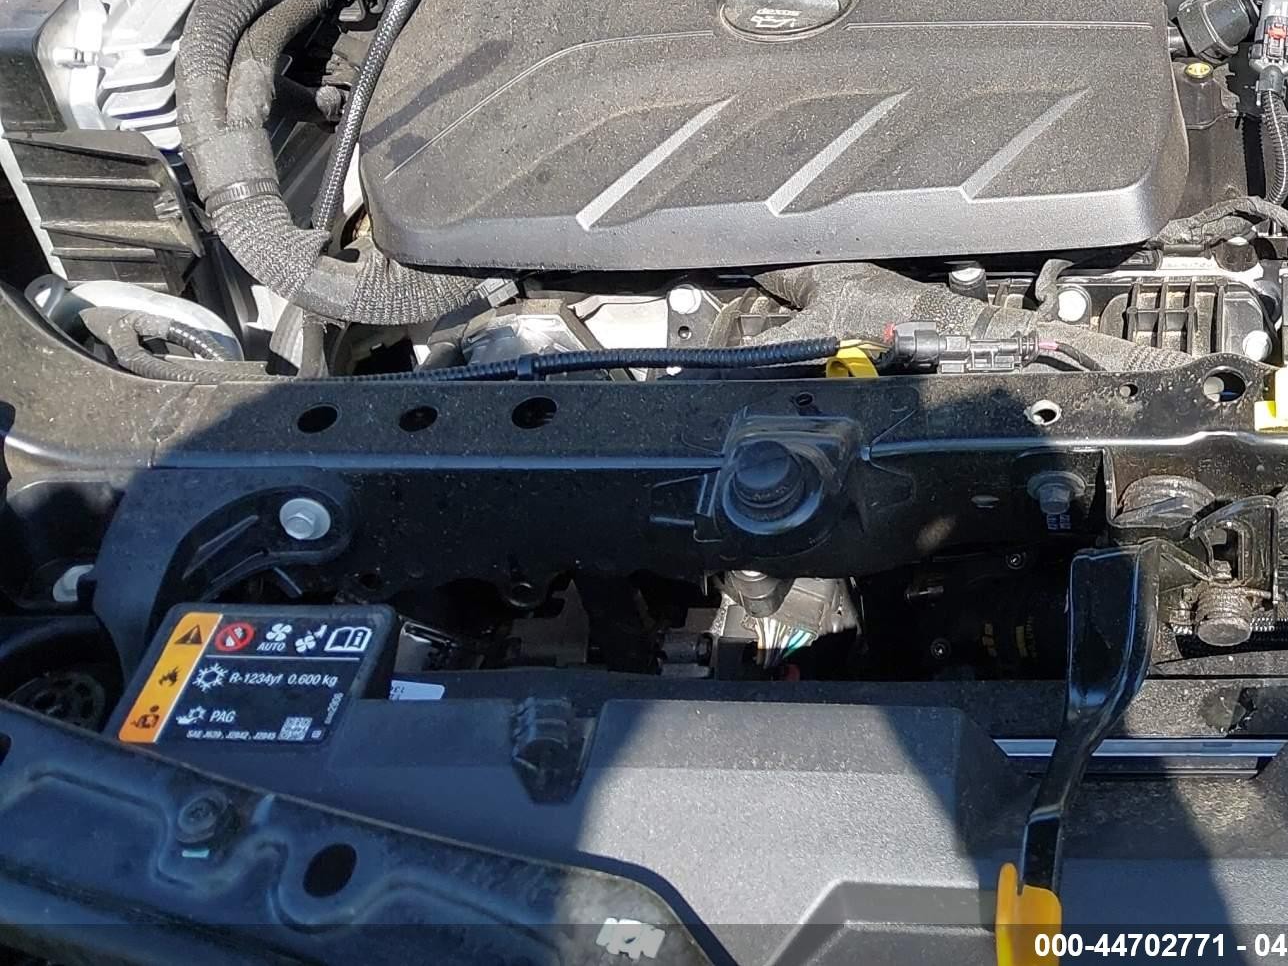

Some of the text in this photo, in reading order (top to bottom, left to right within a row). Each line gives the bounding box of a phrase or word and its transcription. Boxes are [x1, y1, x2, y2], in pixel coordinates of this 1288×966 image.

[257, 642, 286, 652] AUTO
[229, 673, 339, 687] R-1234yf 0.600 kg
[209, 710, 236, 723] PAG
